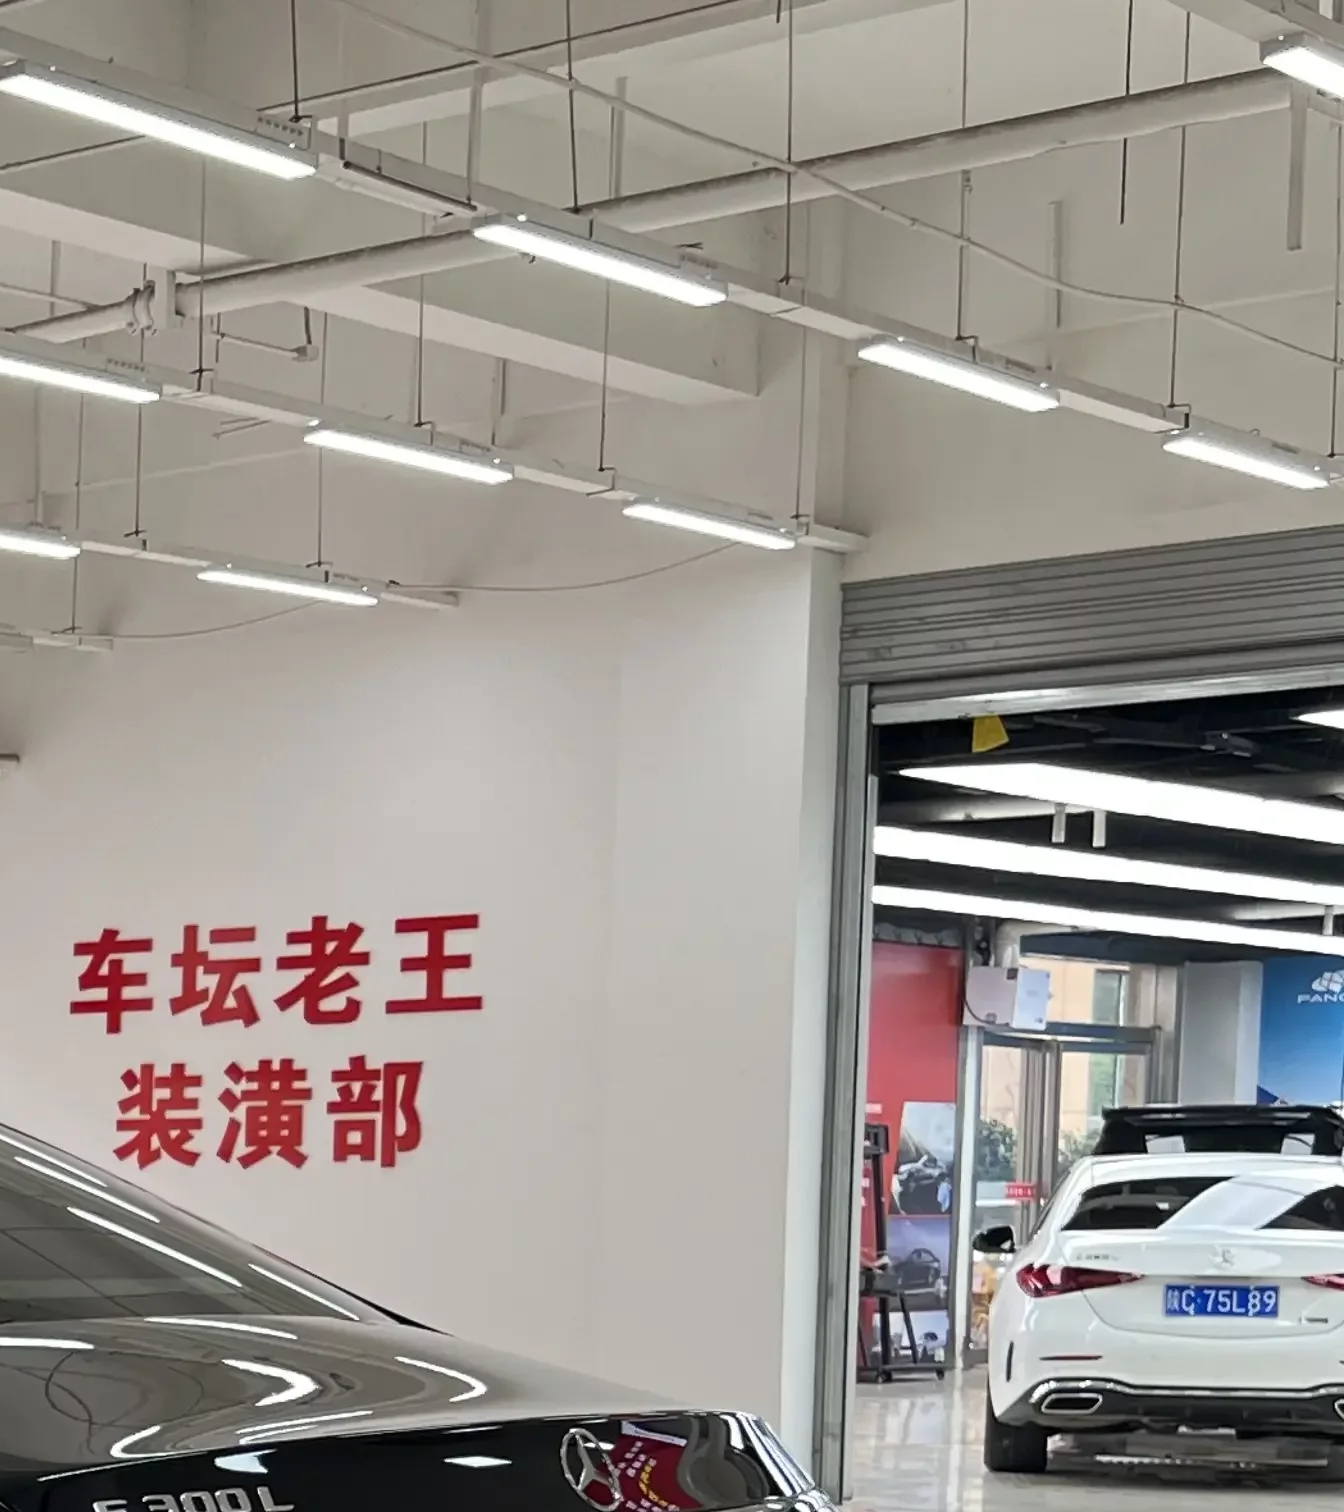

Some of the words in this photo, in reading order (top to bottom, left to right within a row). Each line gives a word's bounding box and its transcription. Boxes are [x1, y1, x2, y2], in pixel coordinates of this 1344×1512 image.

[70, 914, 483, 1035] 车坛老王
[113, 1054, 423, 1169] 装潢部
[256, 1485, 295, 1512] L
